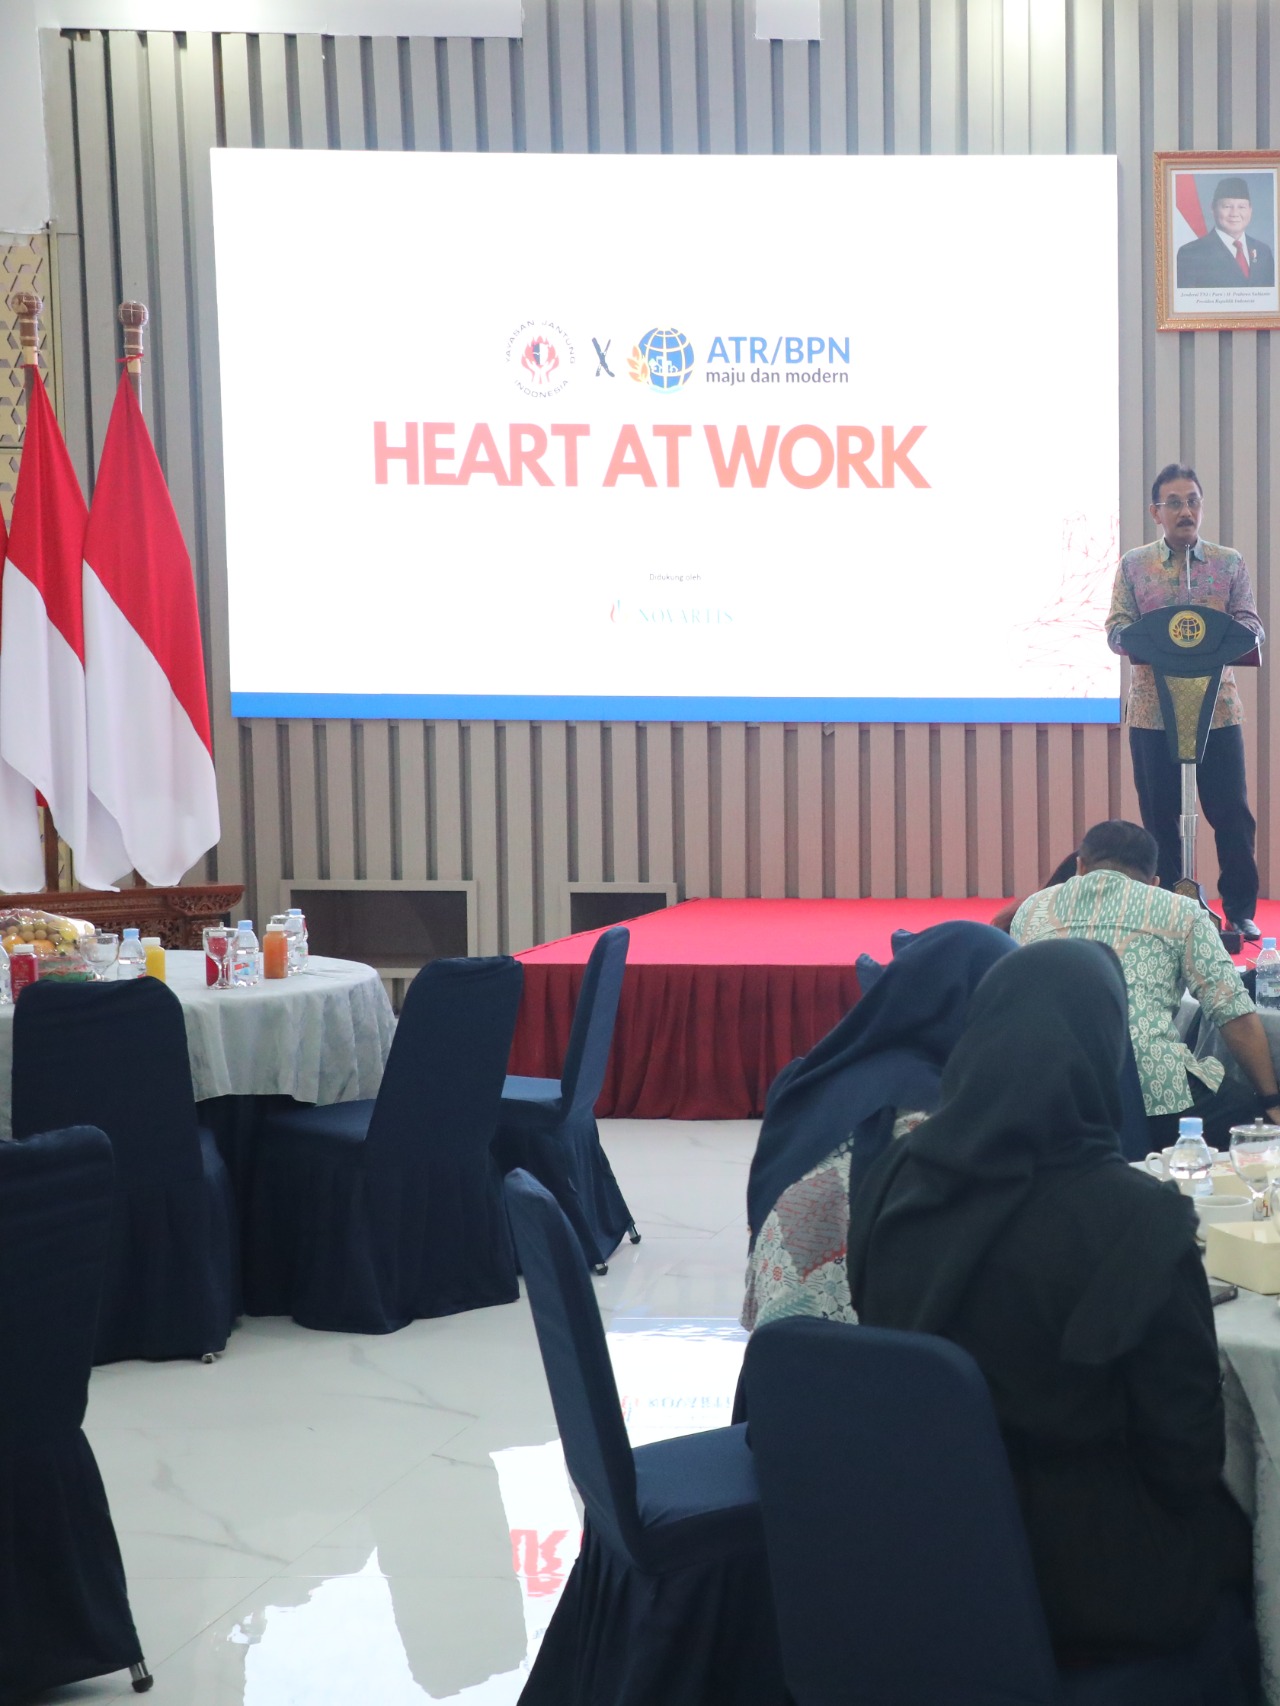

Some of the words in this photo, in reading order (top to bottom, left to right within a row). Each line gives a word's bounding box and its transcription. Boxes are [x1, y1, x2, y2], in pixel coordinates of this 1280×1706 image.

[706, 335, 851, 366] ATR/BPN
[514, 380, 568, 398] INDONESIA
[705, 367, 746, 387] maju
[750, 367, 781, 383] dan
[785, 367, 849, 384] modern
[373, 420, 591, 487] HEART
[602, 423, 693, 488] AT
[702, 423, 932, 490] WORK
